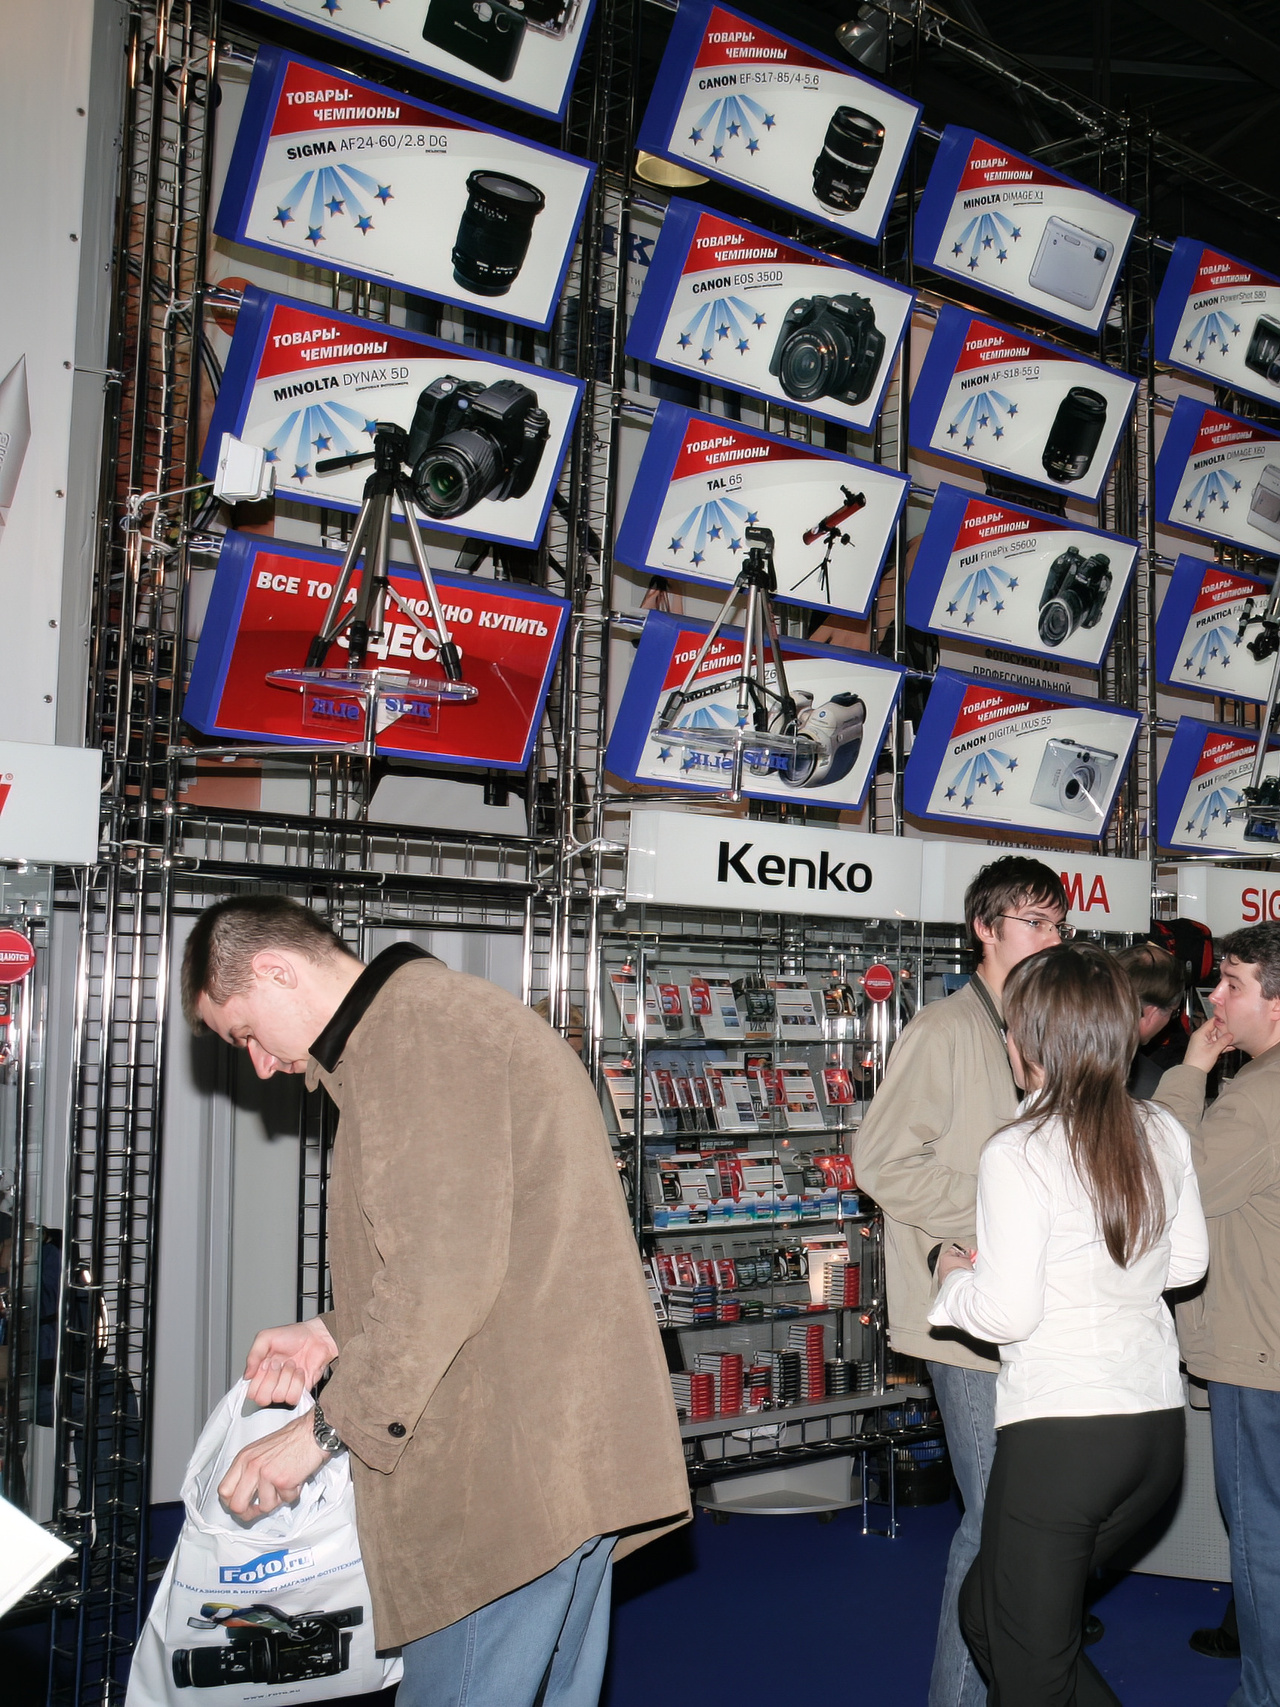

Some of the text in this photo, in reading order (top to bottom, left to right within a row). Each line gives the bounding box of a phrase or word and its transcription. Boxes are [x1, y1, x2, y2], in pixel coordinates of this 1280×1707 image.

[708, 32, 755, 44] ТОВАРЫ-
[725, 48, 787, 59] ЧЕМПИОНЫ
[699, 72, 819, 90] CANON EF-S17-85/4-5.6
[287, 89, 353, 106] ТОВАРЫ-
[314, 107, 400, 122] ЧЕМПИОНЫ
[287, 134, 447, 160] SIGMA AF24-60/2.8 DG
[971, 158, 1008, 170] ТОВАРЫ-
[984, 171, 1033, 181] ЧЕМПИОНЫ
[963, 194, 1000, 209] MINOLTA
[1003, 191, 1033, 202] DIMAGE
[696, 234, 745, 249] ТОВАРЫ-
[714, 248, 778, 261] ЧЕМПИОНЫ
[1200, 264, 1231, 276] ТОВАРЫ-
[692, 276, 731, 294] CANON
[734, 273, 754, 286] EOS
[757, 270, 783, 282] 350D
[1211, 274, 1251, 284] ЧЕМПИОНЫ
[1193, 297, 1219, 310] CANON
[1220, 292, 1253, 303] PowerShot
[273, 327, 340, 348] ТОВАРЫ-
[966, 336, 1004, 351] ТОВАРЫ-
[301, 342, 387, 361] ЧЕМПИОНЫ
[980, 347, 1030, 361] ЧЕМПИОНЫ
[273, 376, 339, 402] MINOLTA
[343, 369, 388, 387] DYNAX
[391, 366, 409, 381] 5D
[961, 374, 989, 390] NIKON
[1033, 366, 1040, 375] G
[1201, 423, 1232, 435] ТОВАРЫ-
[1212, 431, 1253, 444] ЧЕМПИОНЫ
[686, 436, 736, 453] ТОВАРЫ-
[705, 447, 770, 465] ЧЕМПИОНЫ
[1194, 454, 1225, 470] MINOLTA
[707, 478, 727, 491] TAL
[729, 474, 742, 486] 65
[964, 512, 1003, 529] ТОВАРЫ-
[979, 520, 1030, 537] ЧЕМПИОНЫ
[960, 539, 1036, 567] FUJI FinePix S5600
[1201, 579, 1233, 595] ТОВАРЫ-
[1212, 586, 1254, 601] ЧЕМПИОНЫ
[257, 572, 301, 594] ВСЕ
[478, 611, 548, 637] КУПИТЬ
[1196, 608, 1231, 628] PRAKTICA
[972, 666, 1071, 693] ПРОФЕССИОНАЛЬНОЙ
[963, 696, 1003, 715] ТОВАРЫ-
[978, 702, 1030, 722] ЧЕМПИОНЫ
[954, 716, 1051, 755] CANON DIGITAL IXUS 55
[1203, 741, 1235, 758] ТОВАРЫ-
[1214, 745, 1256, 764] ЧЕМПИОНЫ
[1198, 778, 1213, 791] FUJI
[1214, 768, 1238, 784] FinePix
[717, 841, 873, 895] Kenko
[223, 1552, 310, 1582] Foto.ru
[186, 1584, 231, 1594] МАГАЗИНОВ
